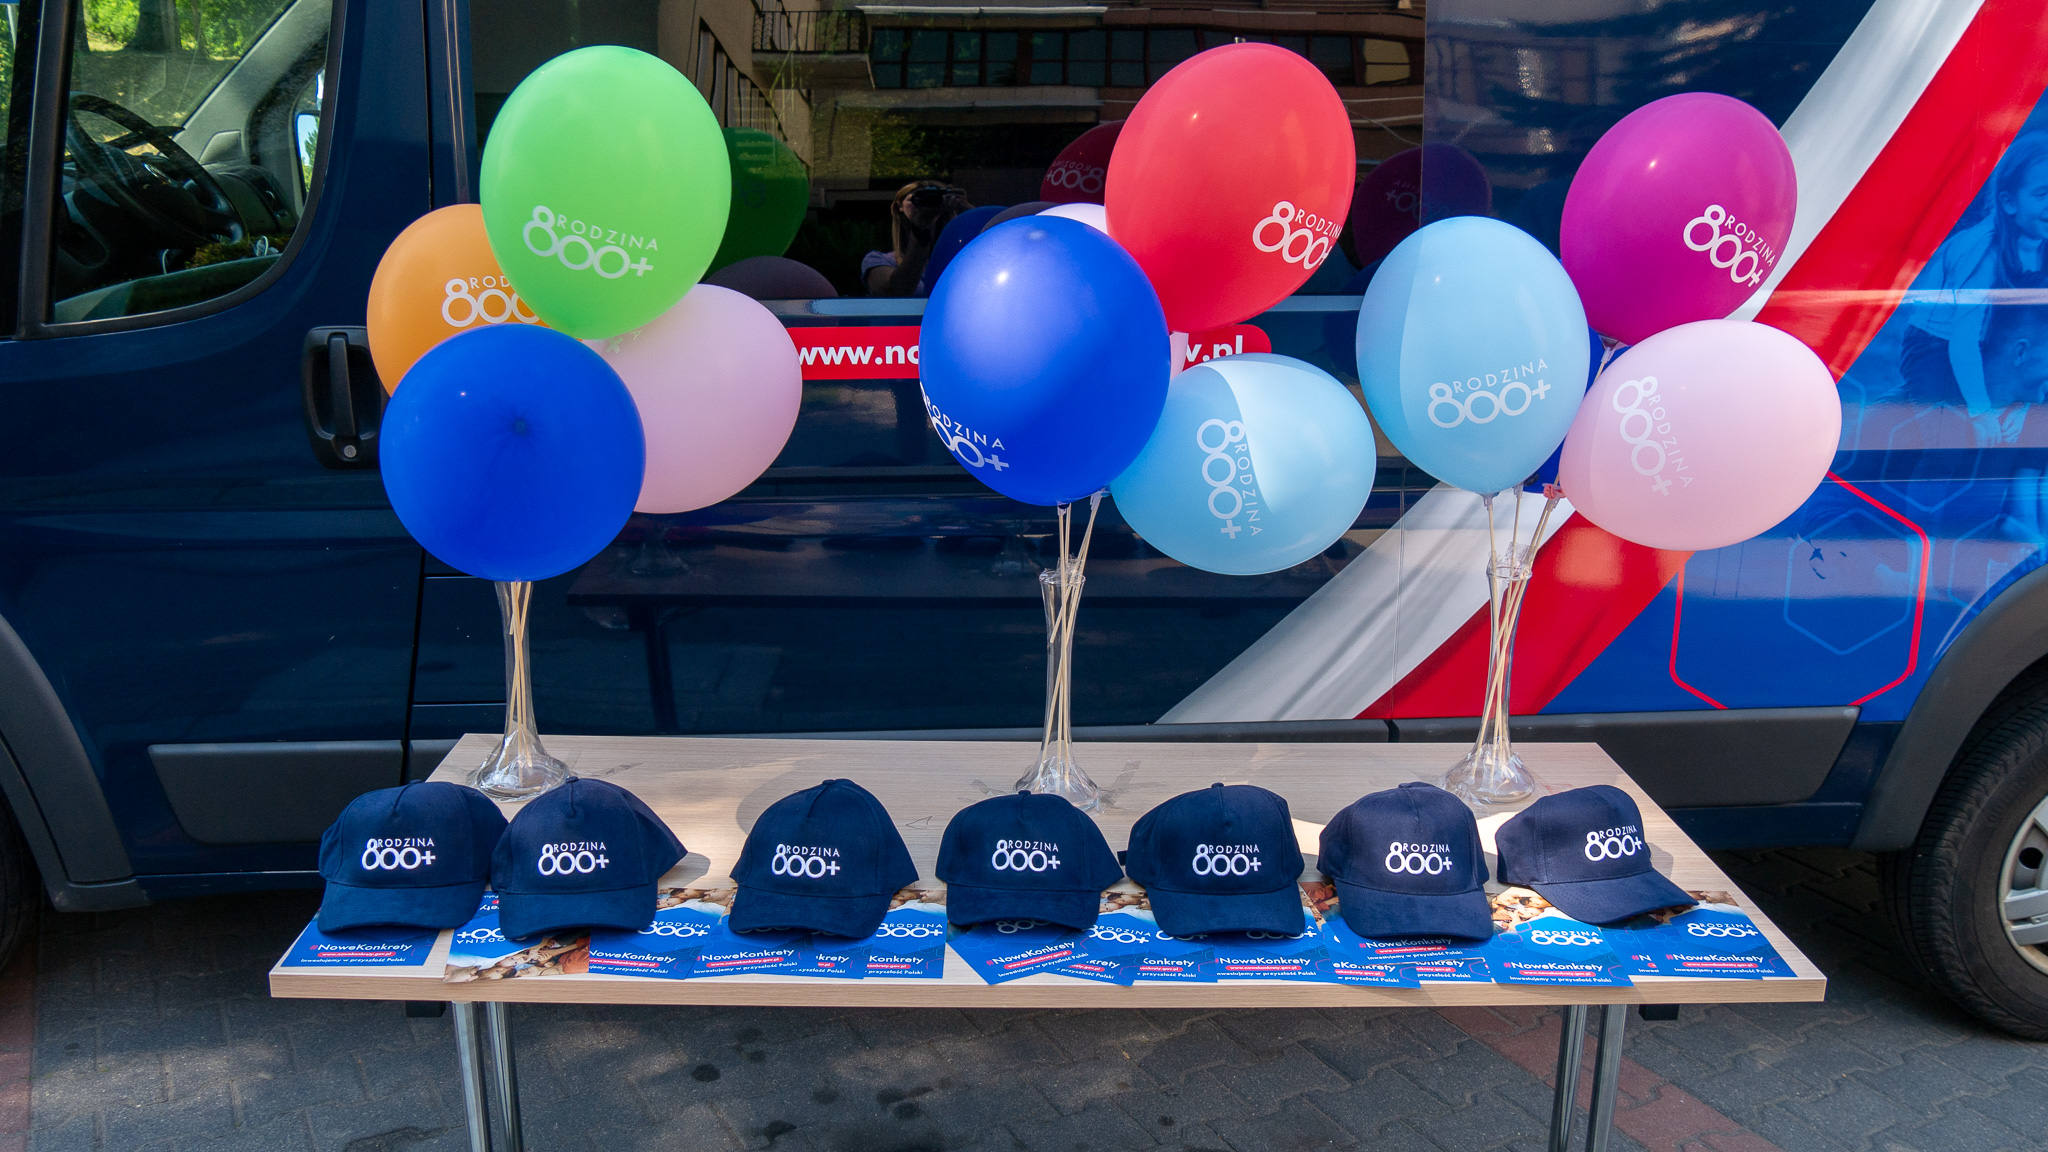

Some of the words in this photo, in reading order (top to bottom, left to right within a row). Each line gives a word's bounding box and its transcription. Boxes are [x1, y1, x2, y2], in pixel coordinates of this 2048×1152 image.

[523, 206, 654, 279] 800+
[557, 214, 658, 250] RODZINA
[1683, 204, 1764, 288] 800+
[1724, 214, 1776, 266] RODZINA
[442, 278, 541, 327] 800
[1452, 358, 1548, 394] RODZINA
[1428, 379, 1552, 428] 800+
[920, 381, 1010, 472] 00+
[926, 395, 1006, 450] RODZINA
[1612, 376, 1672, 496] 800+
[1648, 394, 1694, 488] RODZINA
[1196, 418, 1246, 540] 800+
[1234, 443, 1263, 536] RODZINA
[377, 838, 435, 848] RODZINA
[553, 841, 607, 853] RODZINA
[1008, 840, 1059, 852] RODZINA
[1584, 831, 1642, 862] 800+
[1599, 824, 1638, 839] RODZINA
[362, 838, 436, 870] 800+
[538, 843, 609, 876] 800+
[772, 844, 840, 878] 800+
[786, 844, 840, 858] RODZINA
[992, 839, 1061, 872] 800+
[1192, 843, 1262, 876] 800+
[1208, 843, 1260, 855] RODZINA
[1385, 842, 1452, 875] 800+
[1402, 842, 1451, 853] RODZINA
[658, 921, 711, 929] RODZINA
[1098, 925, 1151, 937] RODZINA
[1531, 930, 1603, 946] 800+
[1687, 922, 1758, 938] 800+
[309, 943, 413, 952] #NoweKonkrety
[590, 950, 676, 964] NoweKonkrety
[986, 942, 1075, 966] #NoweKonkrety
[1359, 938, 1452, 949] #NoweKonkrety
[1665, 953, 1764, 963] #NoweKonkrety
[869, 955, 924, 965] Konkrety
[1142, 957, 1195, 968] Konkrety
[1503, 961, 1603, 972] #NoweKonkrety
